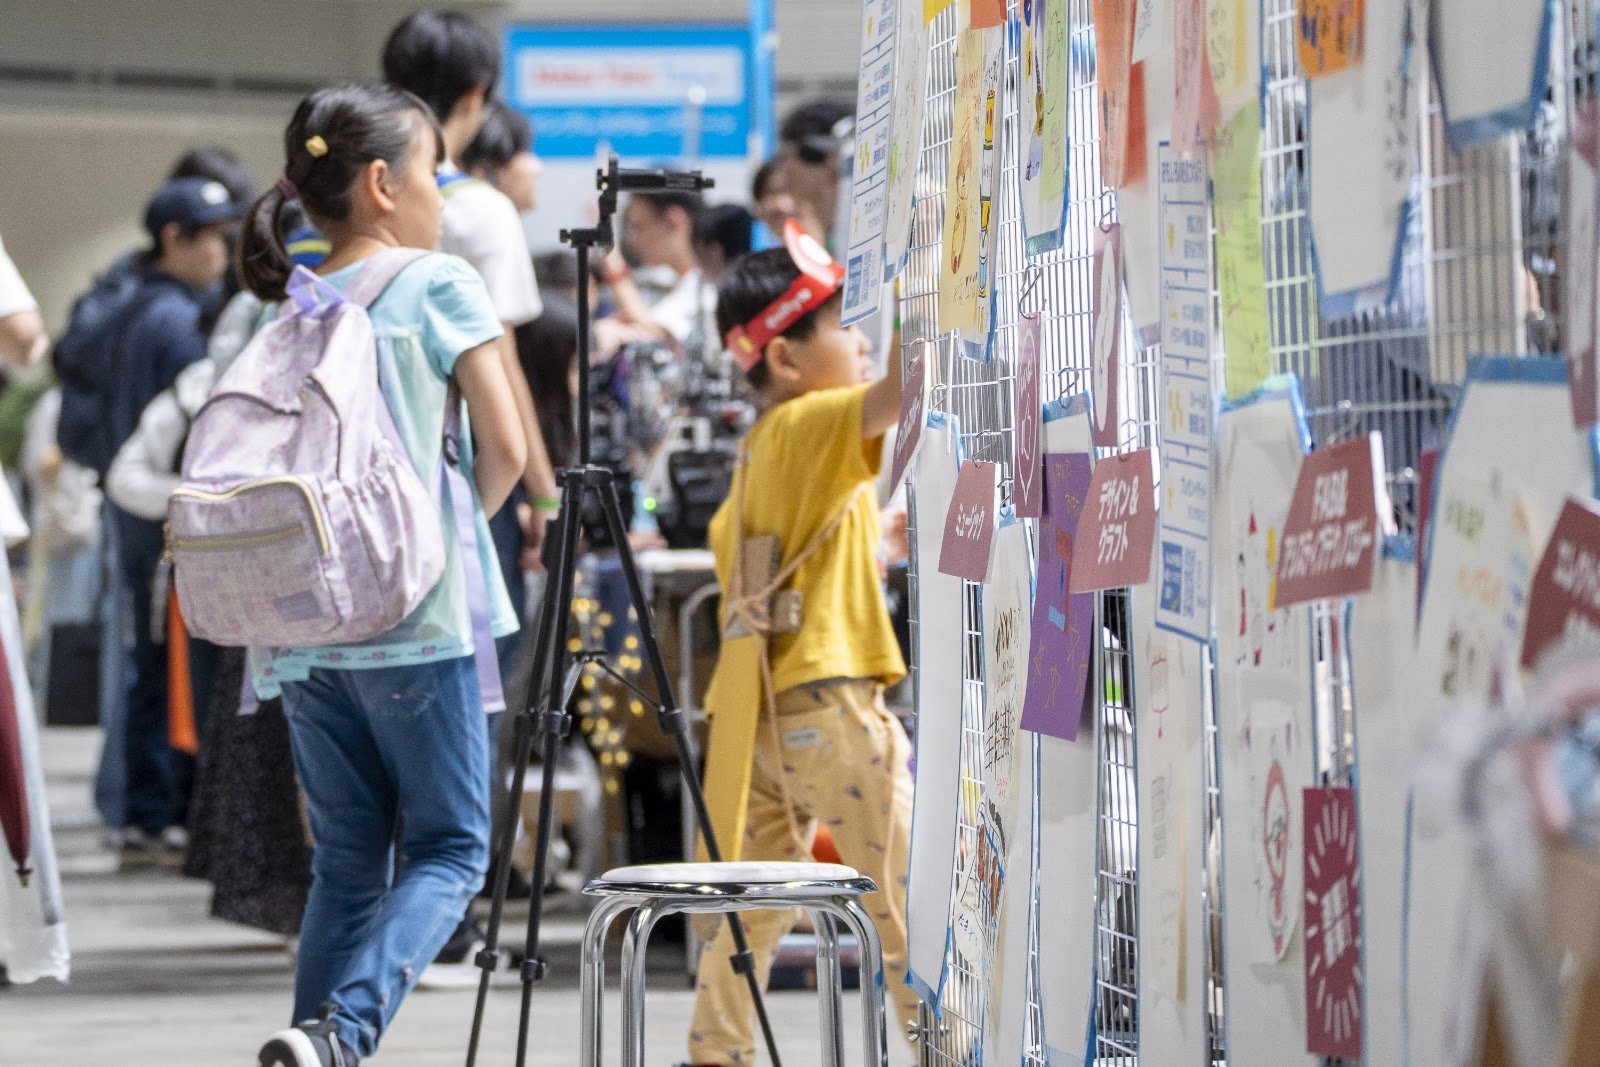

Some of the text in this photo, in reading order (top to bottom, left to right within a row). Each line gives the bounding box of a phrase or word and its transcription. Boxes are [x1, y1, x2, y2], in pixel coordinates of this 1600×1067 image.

[1098, 475, 1140, 522] デザイン&
[956, 504, 985, 541] ミュージック
[1097, 521, 1130, 565] クラフト
